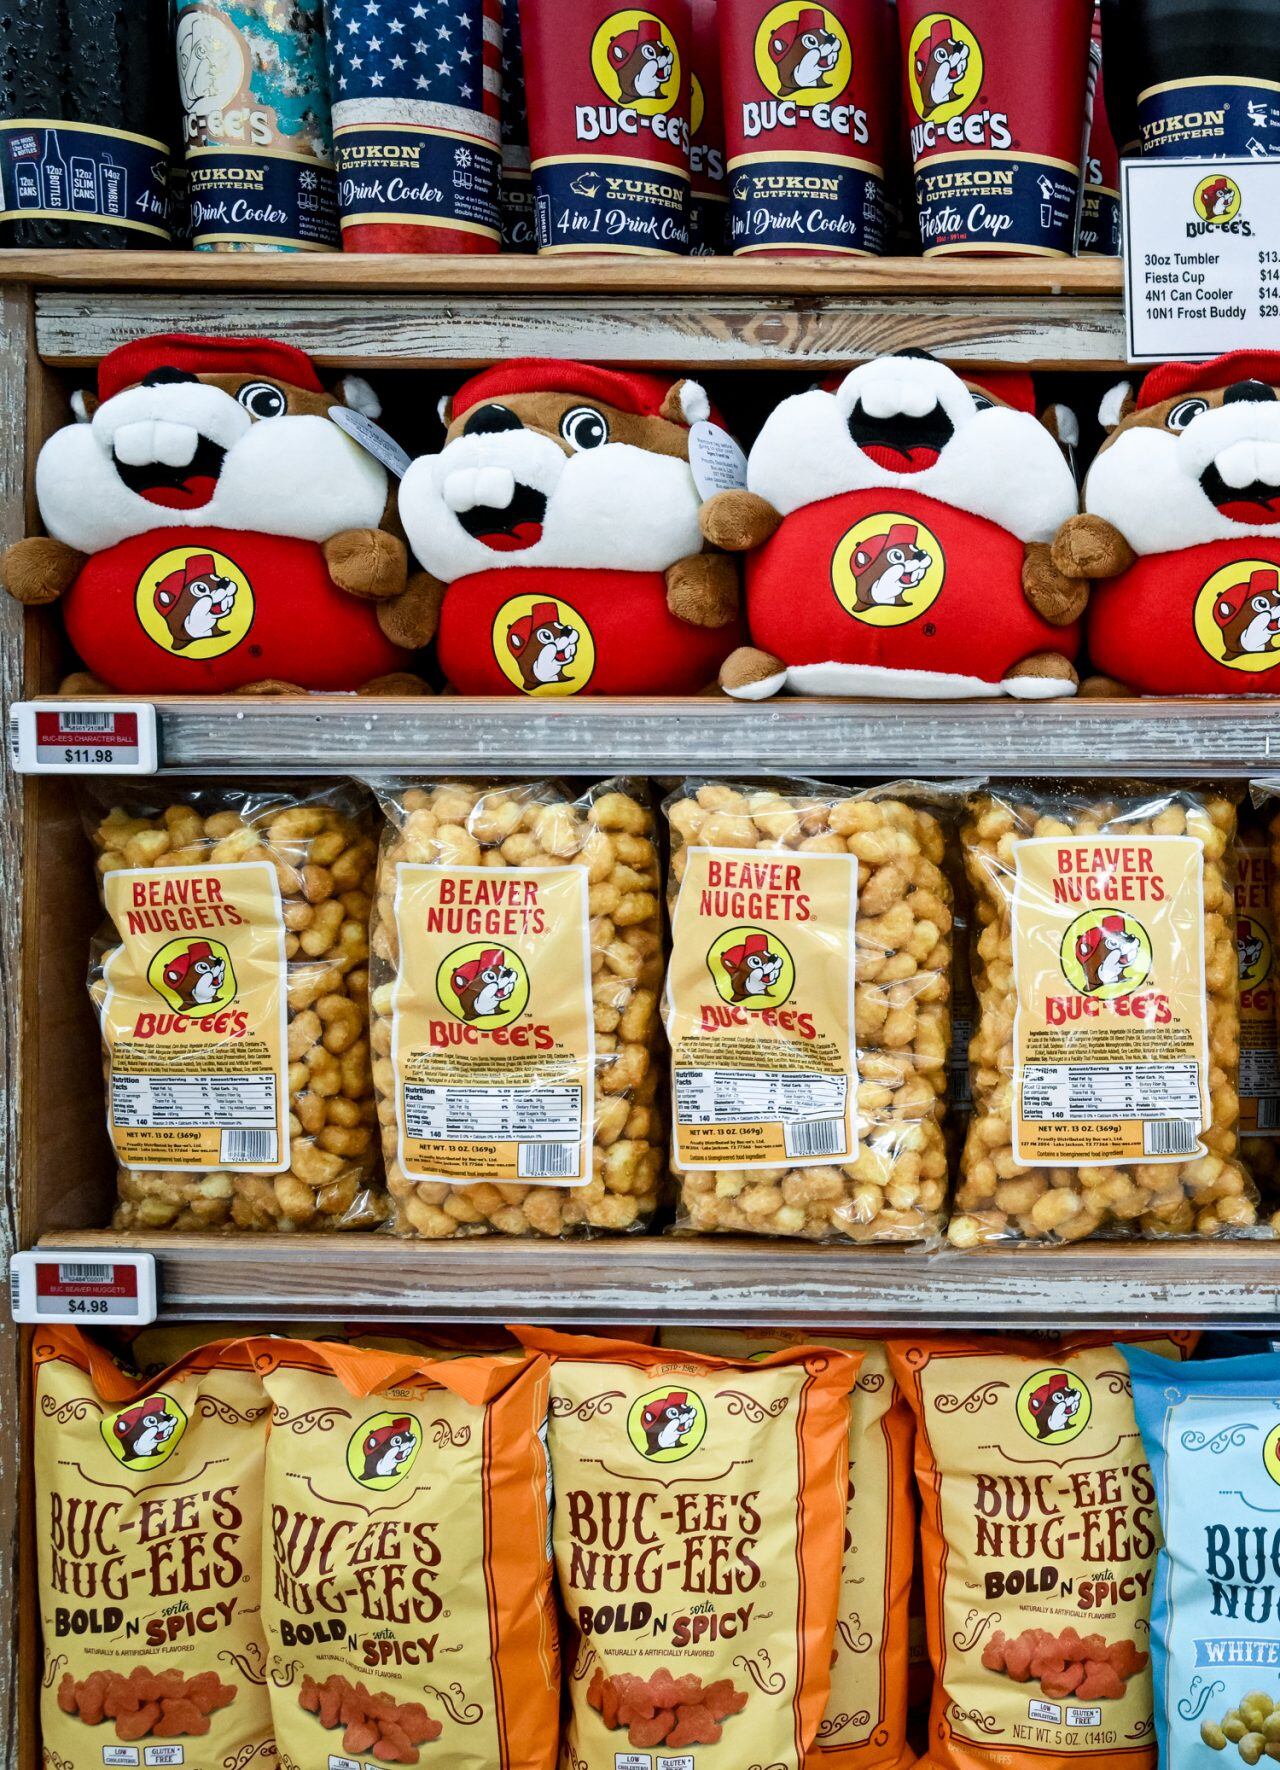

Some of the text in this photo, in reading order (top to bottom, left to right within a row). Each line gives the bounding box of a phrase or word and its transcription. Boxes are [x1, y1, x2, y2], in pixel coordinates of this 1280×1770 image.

[576, 105, 690, 155] BUC-EE'S
[743, 101, 869, 143] BUC-EE'S
[911, 110, 1012, 162] BUC-EE'S
[1142, 110, 1225, 139] YUKON
[342, 145, 420, 159] YUKON
[1144, 127, 1224, 152] OUTFITTERS
[191, 168, 264, 182] YUKON
[342, 160, 420, 168] OUTFITTERS
[20, 187, 37, 196] CANS
[50, 175, 61, 206] BOTTLES
[74, 179, 93, 189] SLIM
[74, 188, 94, 199] CANS
[192, 182, 264, 191] OUTFITTERS
[343, 179, 385, 206] Drink
[387, 178, 443, 202] Cooler
[605, 178, 683, 201] YUKON
[753, 177, 839, 191] YUKON
[925, 171, 1013, 190] YUKON
[927, 187, 1013, 202] OUTFITTERS
[109, 180, 118, 213] TUMBLER
[606, 191, 682, 210] OUTFITTERS
[754, 191, 838, 200] OUTFITTERS
[231, 200, 288, 223] Cooler
[605, 209, 660, 239] Drink
[754, 208, 856, 235] Drink Cooler
[919, 205, 963, 243] Fiesta
[967, 203, 1013, 237] Cup
[1186, 220, 1252, 238] BUC-EE'S
[1145, 255, 1170, 265] 30oz
[1174, 253, 1220, 265] Tumbler
[1145, 272, 1178, 283] Fiesta
[1183, 272, 1205, 285] Cup
[1146, 290, 1166, 301] 4N1
[1170, 290, 1192, 301] Can
[1196, 288, 1233, 300] Cooler
[1147, 308, 1173, 319] 10N1
[1178, 307, 1206, 319] Frost
[1210, 306, 1246, 320] Buddy
[65, 749, 113, 763] $11.98
[1057, 848, 1153, 873] BEAVER
[708, 860, 801, 891] BEAVER
[1053, 875, 1164, 904] NUGGETS
[133, 877, 223, 908] BEAVER
[439, 879, 538, 907] BEAVER
[700, 890, 811, 921] NUGGETS
[127, 904, 243, 935] NUGGETS
[427, 907, 545, 935] NUGGETS
[700, 1004, 816, 1039] BUC-EE'S
[1045, 994, 1172, 1025] BUC-EE'S
[133, 1012, 249, 1039] BUC-EE'S
[429, 1021, 554, 1050] BUC-EE'S
[1096, 1124, 1122, 1133] (369g)
[69, 1300, 108, 1313] $4.98
[972, 1463, 1156, 1522] BUC-EE'S
[50, 1485, 243, 1559] BUC-EE'S
[566, 1490, 761, 1551] BUC-EE'S
[974, 1506, 1156, 1562] NUG-EES
[272, 1504, 442, 1579] BUC-EE'S
[51, 1532, 243, 1600] NUG-EES
[569, 1535, 762, 1595] NUG-EES
[274, 1556, 443, 1624] NUG-EES
[984, 1566, 1151, 1610] BOLD sorta SPICY
[55, 1598, 239, 1646] BOLD N sorta SPICY
[578, 1600, 755, 1648] BOLD N sorta SPICY
[280, 1619, 439, 1666] BOLD SPICY
[645, 1649, 682, 1657] ARTIFICIALLY
[1205, 1641, 1279, 1664] WHITE
[1012, 1724, 1117, 1745] NET WT. 5 OZ. (141G)
